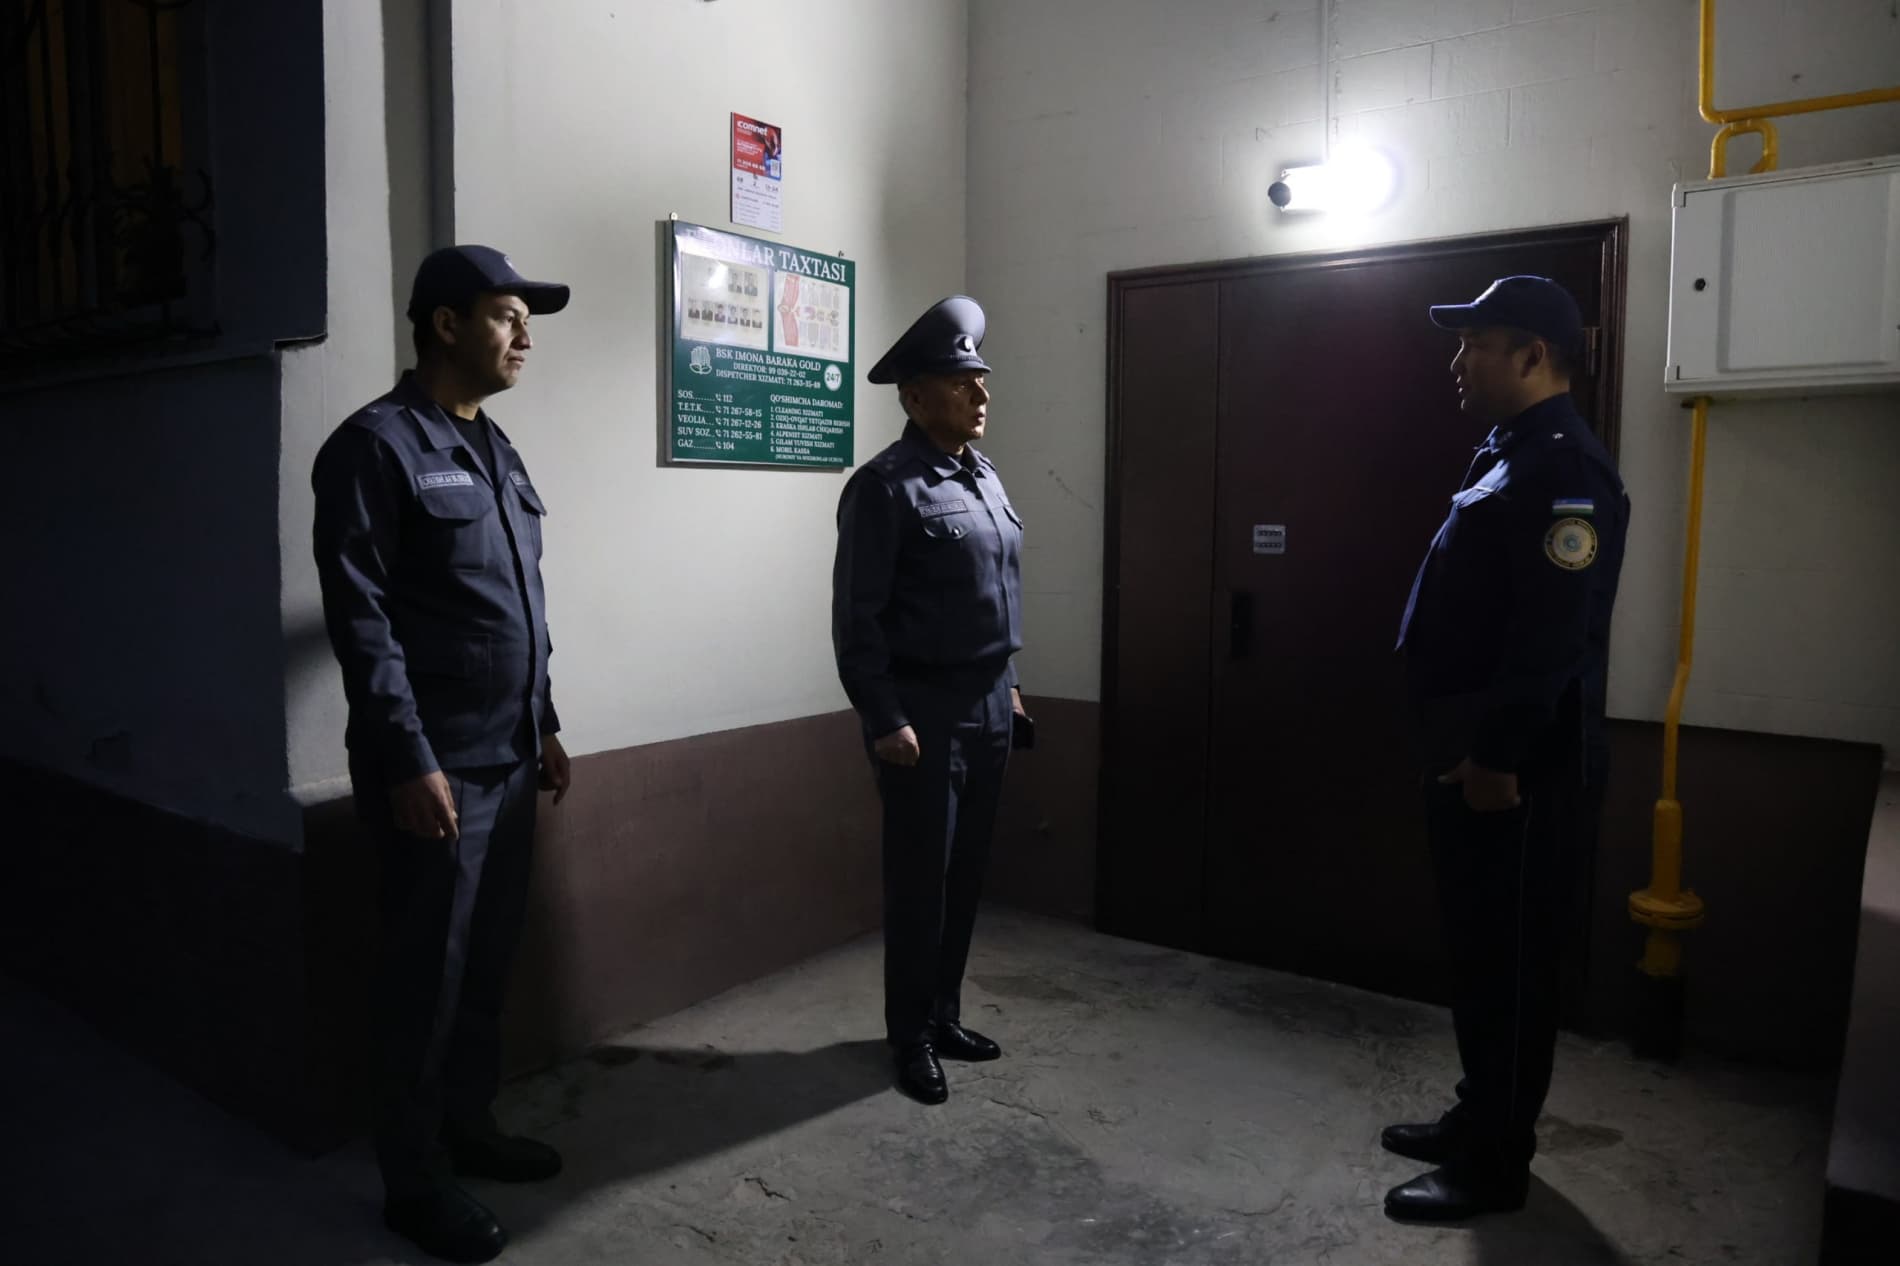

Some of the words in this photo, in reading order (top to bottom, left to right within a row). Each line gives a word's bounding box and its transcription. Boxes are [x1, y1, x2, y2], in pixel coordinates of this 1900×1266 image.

[737, 120, 768, 137] comnet
[779, 251, 846, 283] TAXTASI
[716, 347, 733, 359] BSK
[735, 350, 764, 363] IMONA
[766, 355, 797, 369] BARAKA
[799, 360, 821, 371] GOLD
[716, 369, 757, 381] DISPETCHER
[723, 394, 733, 403] 112
[723, 405, 730, 414] 71
[723, 418, 730, 426] 71
[677, 426, 694, 435] SUV
[723, 429, 730, 438] 71
[723, 441, 735, 451] 104
